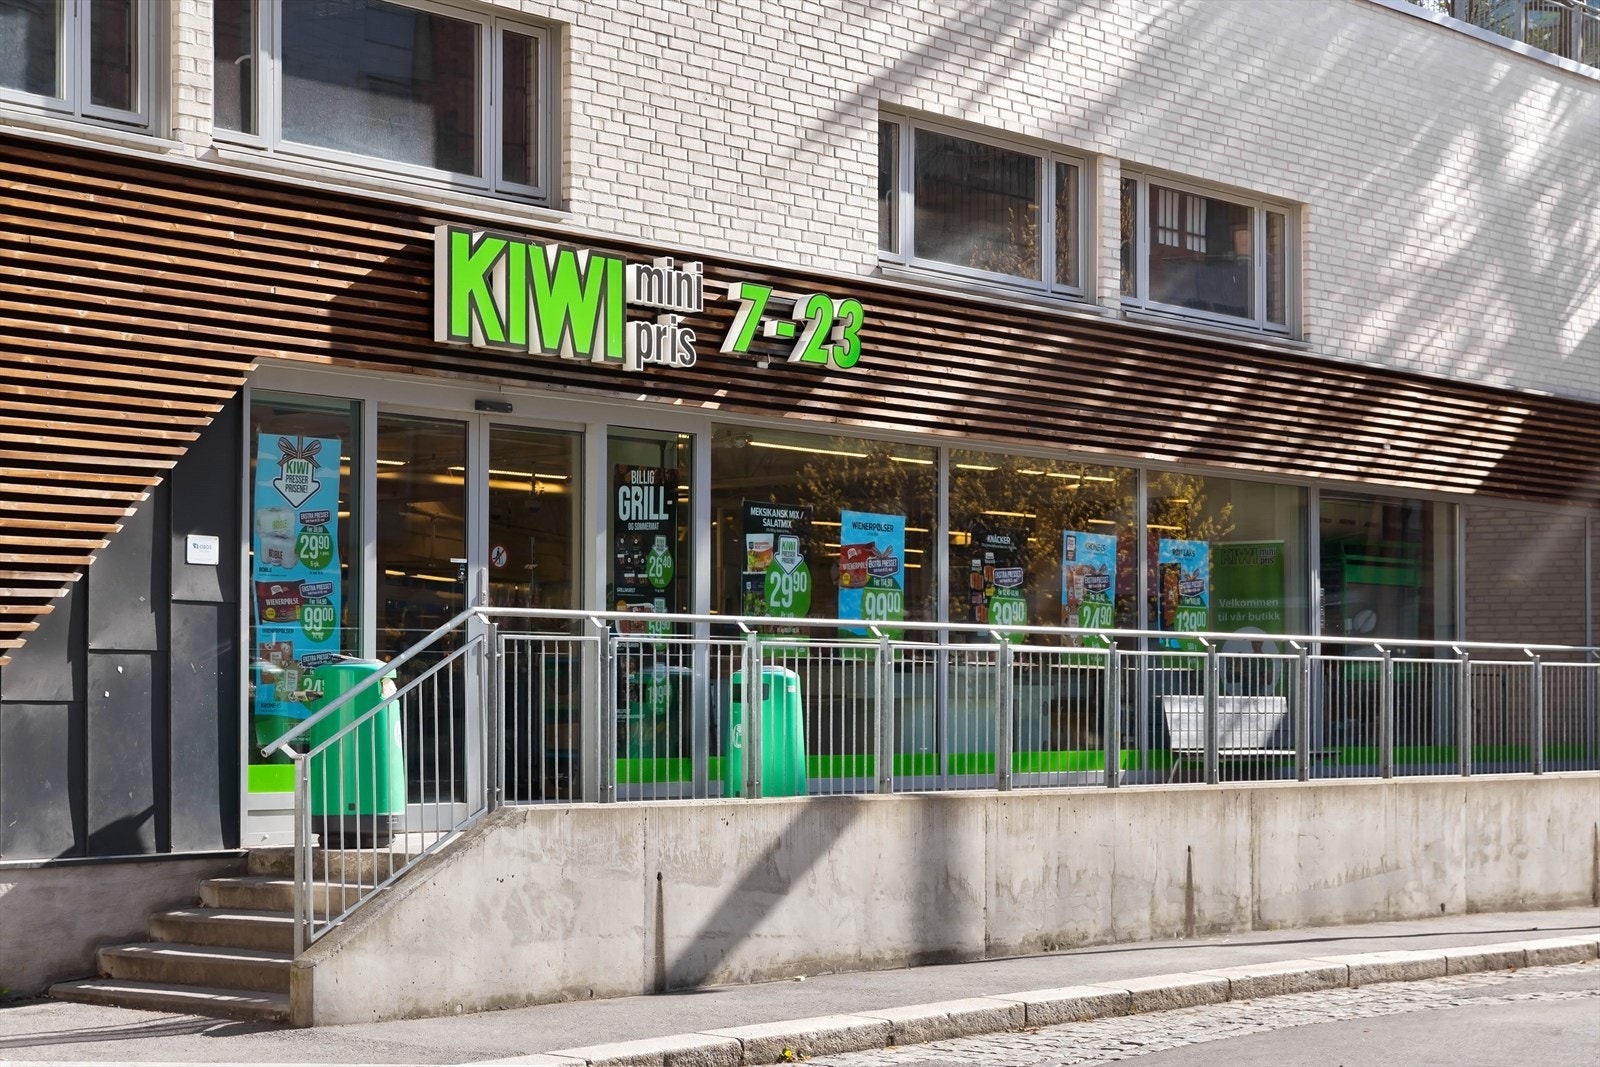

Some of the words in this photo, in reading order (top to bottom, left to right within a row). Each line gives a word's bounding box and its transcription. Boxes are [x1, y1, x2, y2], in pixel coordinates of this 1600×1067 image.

[634, 257, 704, 313] mini
[444, 226, 627, 363] KIWI
[634, 314, 698, 371] pris
[286, 461, 309, 474] KIWI
[285, 475, 309, 484] PRESSER
[631, 470, 655, 485] BILLIG
[285, 484, 308, 494] PRISENE!
[750, 507, 788, 518] MEKSIKANSK
[789, 510, 800, 519] MIX
[762, 518, 792, 529] SALATMIX
[852, 521, 894, 532] WIENERPØLSER
[1260, 556, 1275, 566] pris
[1219, 599, 1278, 607] Velkommen
[1217, 613, 1229, 622] til
[1230, 612, 1246, 622] vår
[1248, 611, 1281, 621] butikk
[302, 655, 316, 663] EKSTRA
